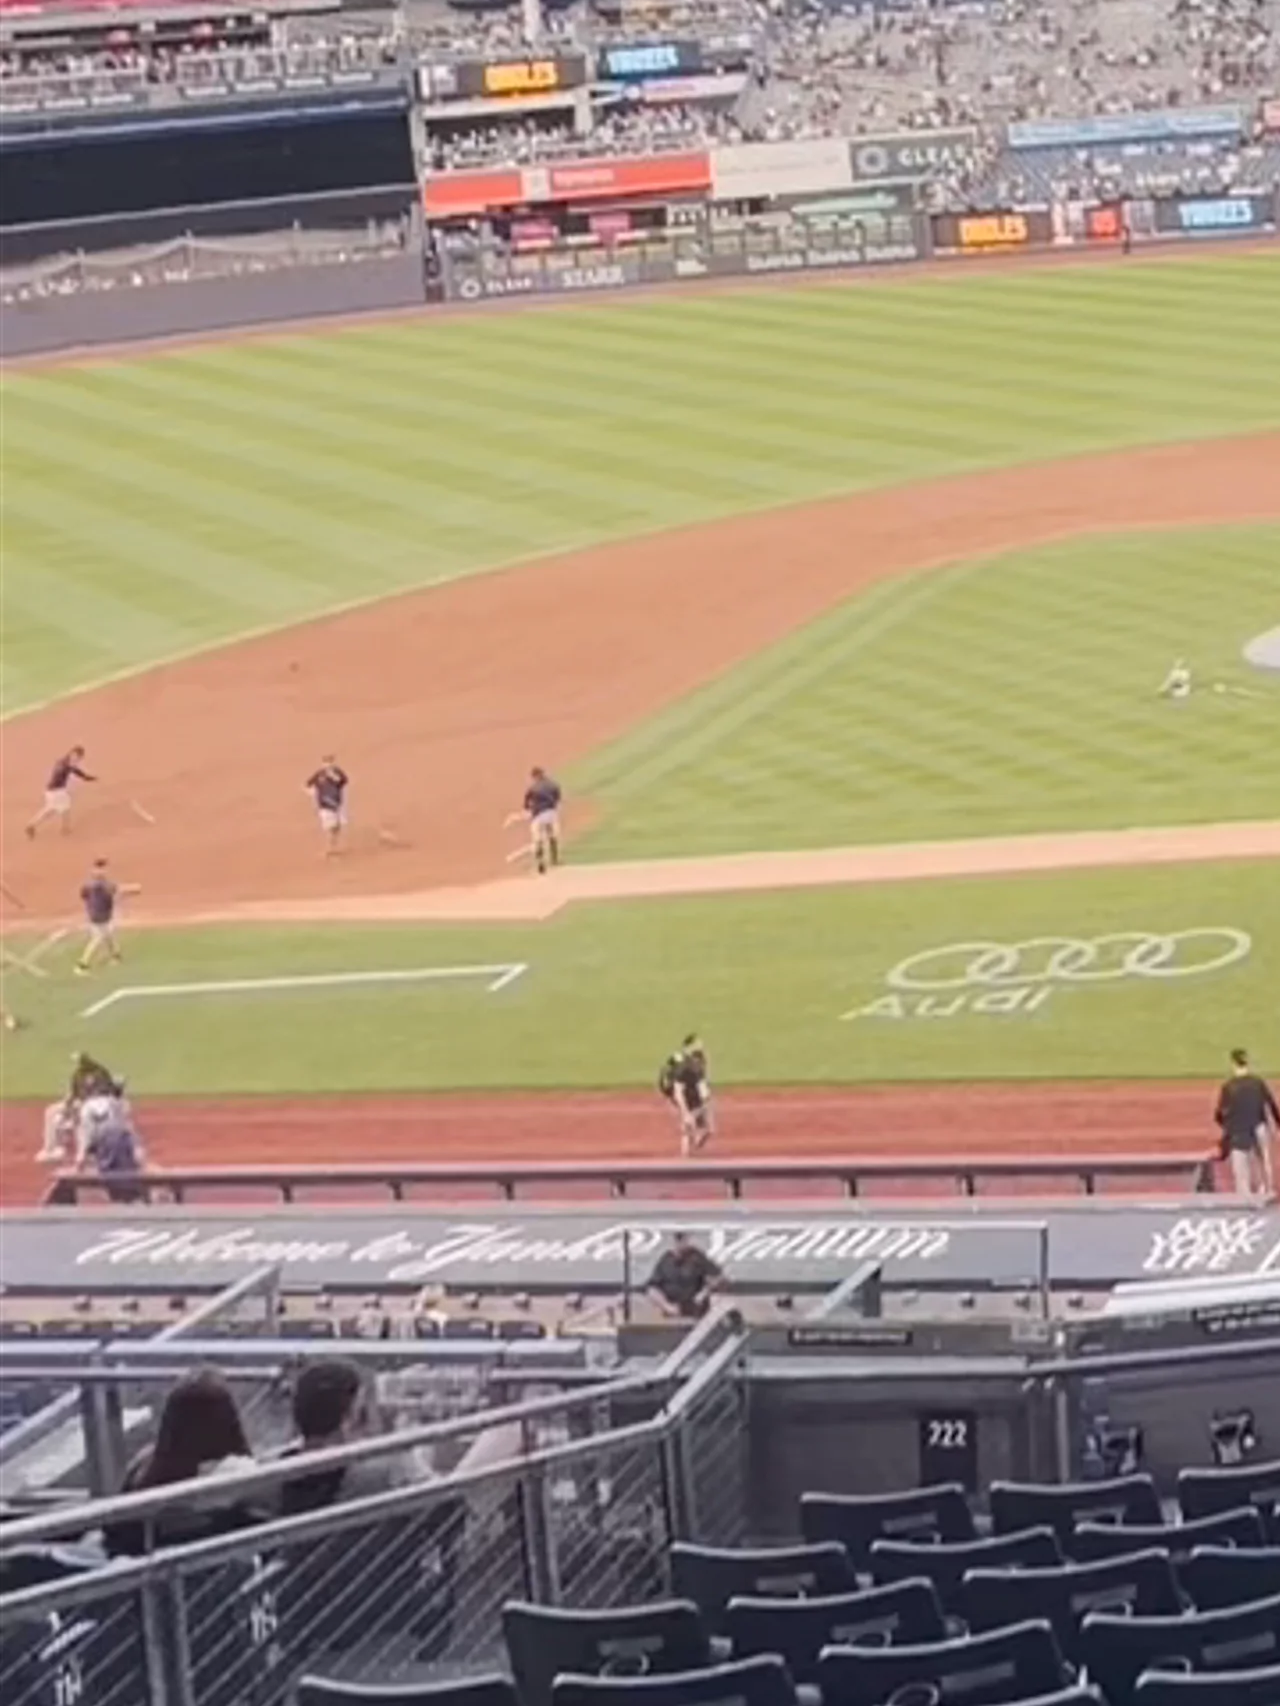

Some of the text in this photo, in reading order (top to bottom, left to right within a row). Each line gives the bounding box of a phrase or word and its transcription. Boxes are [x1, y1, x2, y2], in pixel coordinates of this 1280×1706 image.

[837, 985, 1055, 1021] Audi
[76, 1226, 350, 1265] Welcome
[350, 1230, 424, 1262] to
